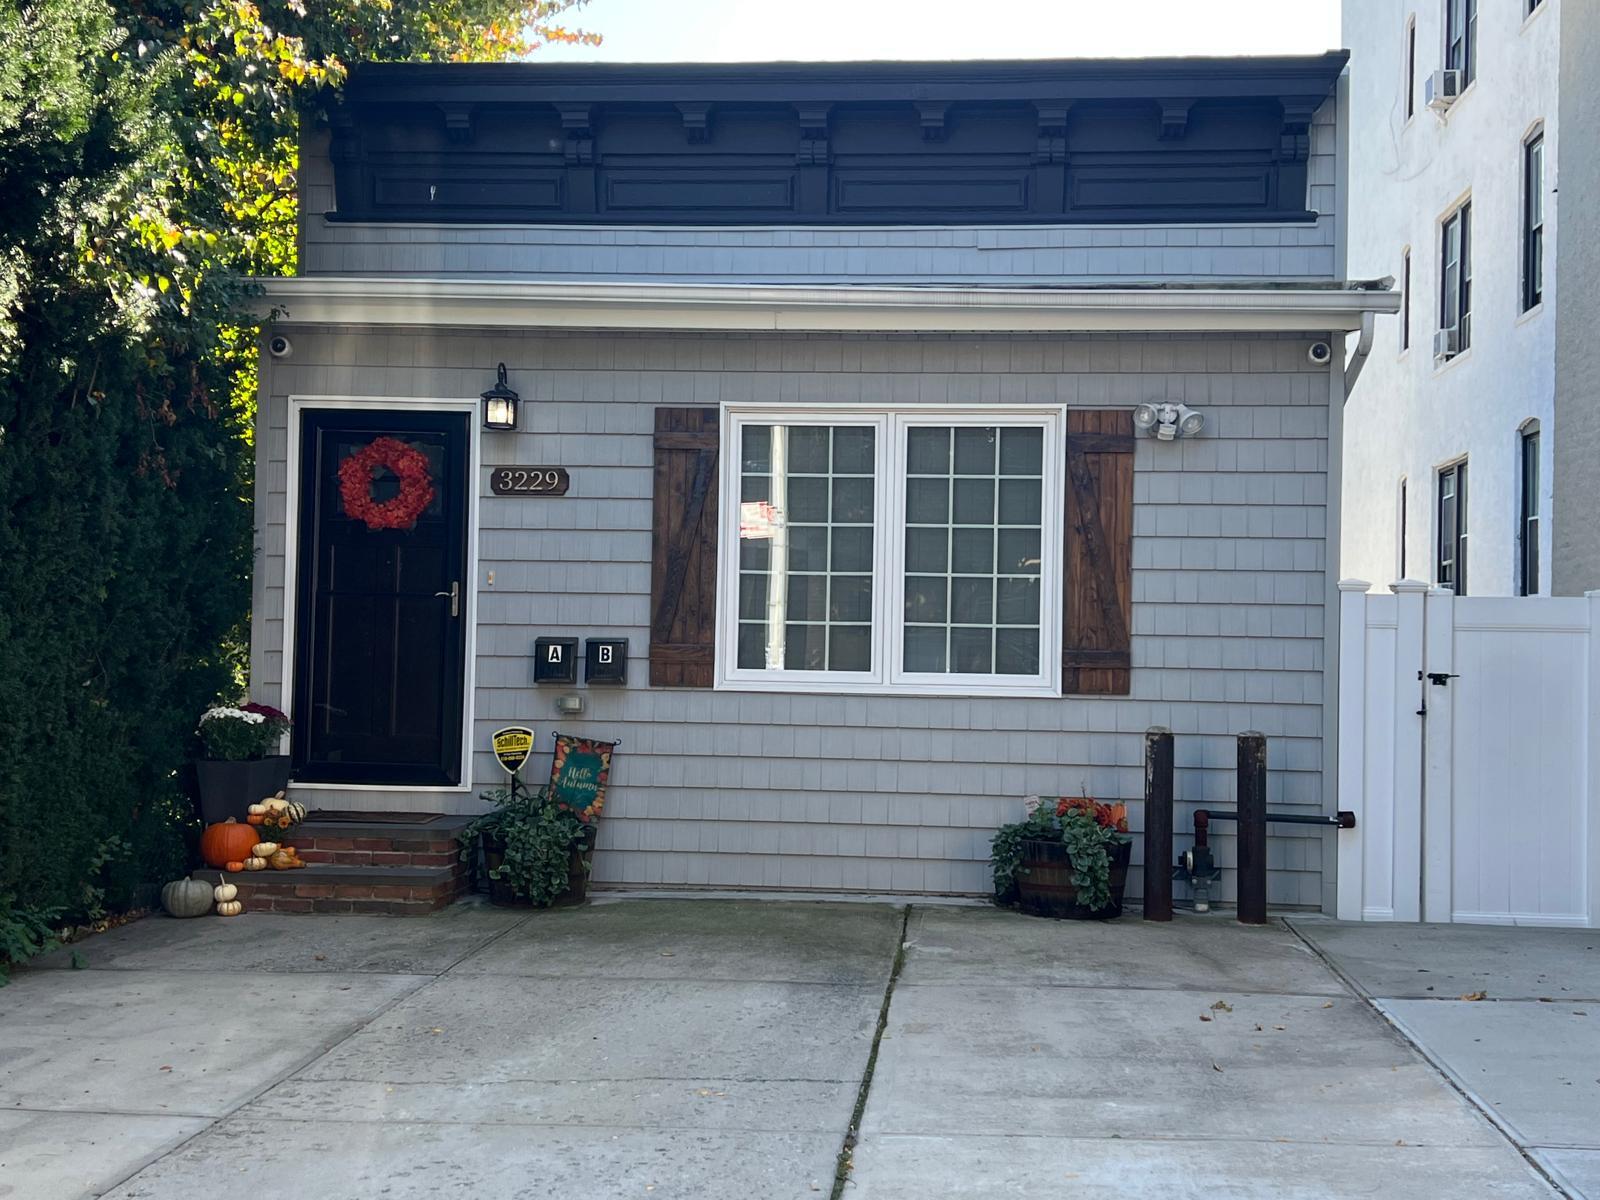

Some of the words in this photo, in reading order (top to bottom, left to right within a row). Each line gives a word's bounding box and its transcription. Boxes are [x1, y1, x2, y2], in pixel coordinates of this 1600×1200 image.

[499, 470, 559, 490] 3229
[549, 646, 560, 661] A
[600, 647, 611, 662] B
[568, 766, 592, 778] Hello
[560, 776, 598, 791] Autumn
